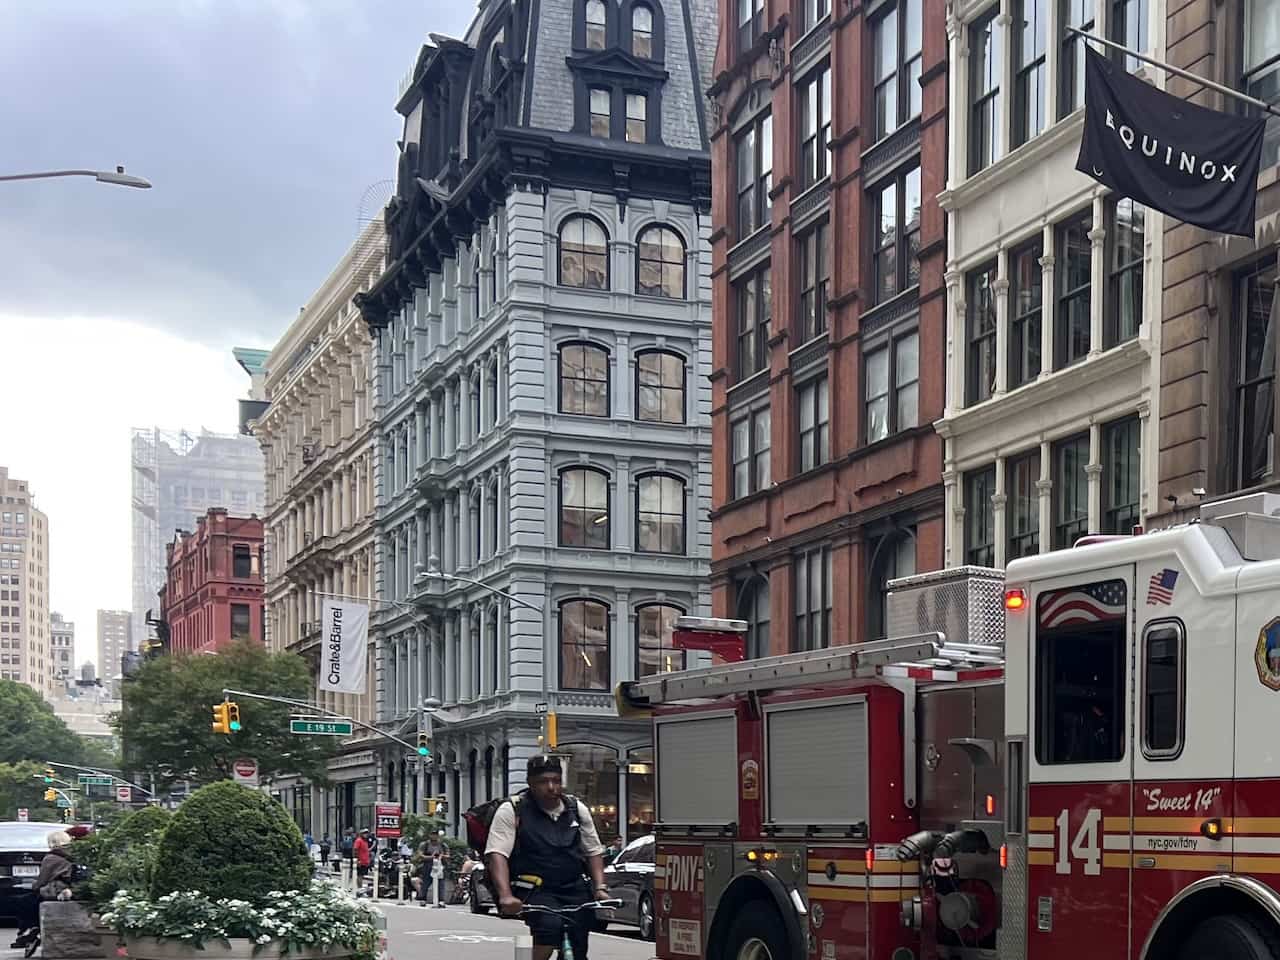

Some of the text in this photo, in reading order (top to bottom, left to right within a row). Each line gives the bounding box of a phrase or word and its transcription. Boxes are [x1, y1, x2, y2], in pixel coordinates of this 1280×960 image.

[1106, 108, 1237, 183] EQUINOX
[327, 607, 343, 685] Crate&Barrel
[315, 724, 324, 732] 19
[665, 855, 699, 892] FDNY
[1055, 808, 1102, 875] 14
